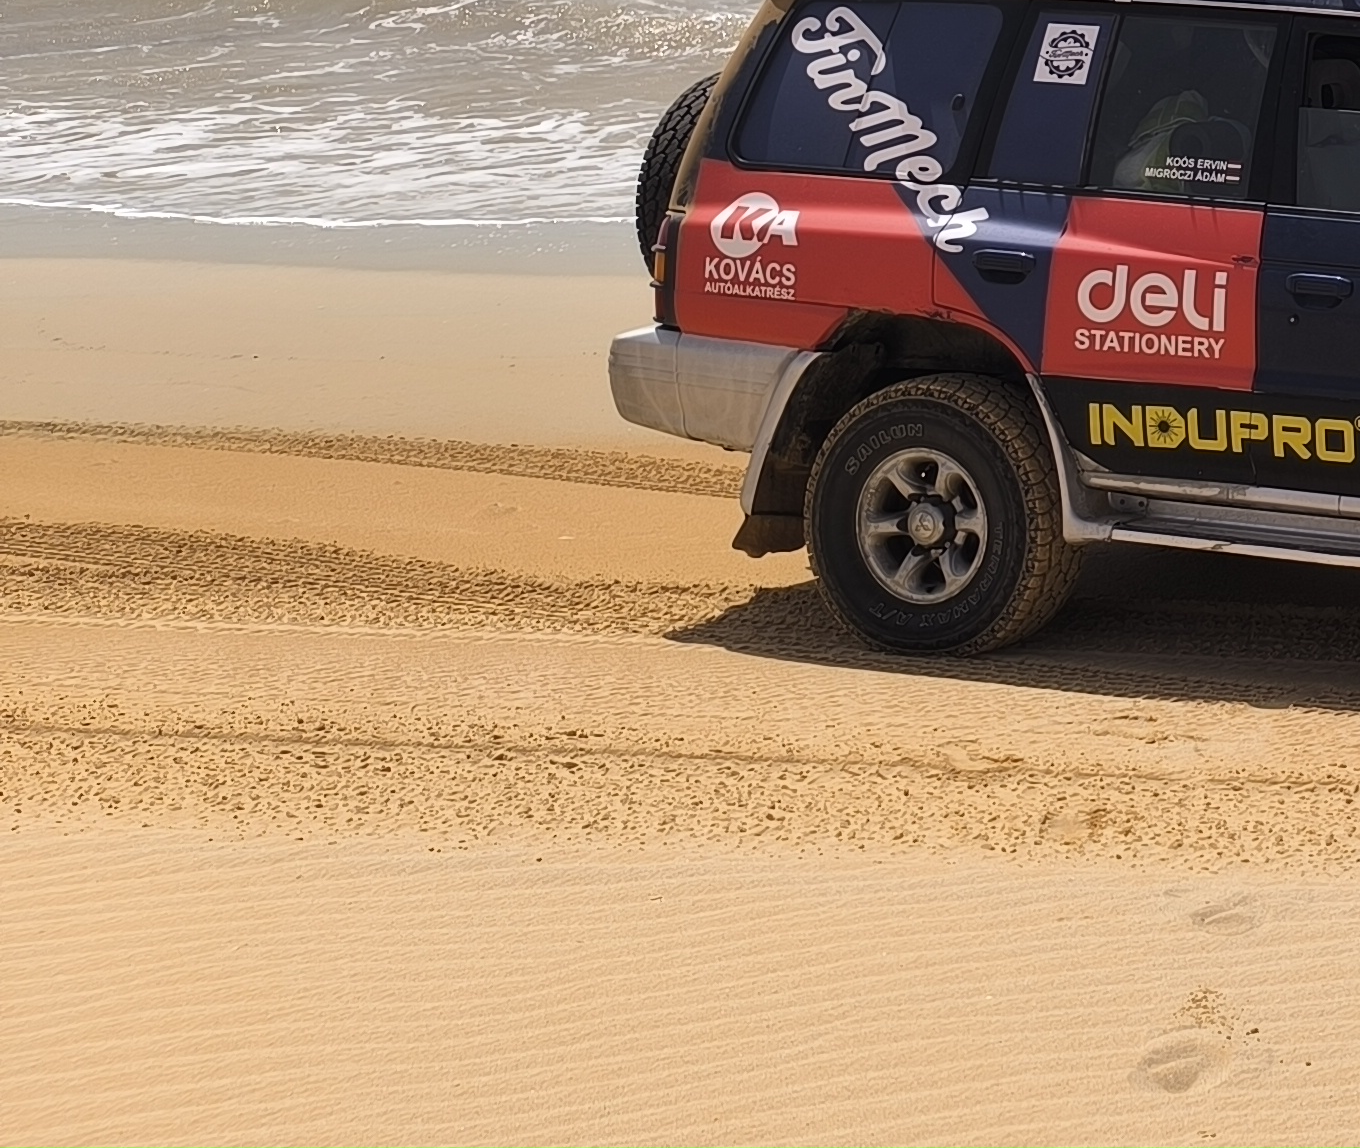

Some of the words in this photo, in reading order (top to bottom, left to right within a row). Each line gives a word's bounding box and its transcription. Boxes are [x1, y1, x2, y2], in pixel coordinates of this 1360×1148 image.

[791, 6, 989, 253] FinMech
[1145, 167, 1194, 180] MIGRÓCZI
[1195, 170, 1226, 183] ÁDÁM
[1166, 155, 1195, 168] KOÓS
[1197, 159, 1227, 170] ERVIN
[705, 256, 796, 286] KOVÁCS
[705, 281, 796, 301] AUTÓALKATRÉSZ
[1077, 264, 1228, 332] deli
[1074, 328, 1225, 359] STATIONERY
[844, 423, 924, 476] SAILUN
